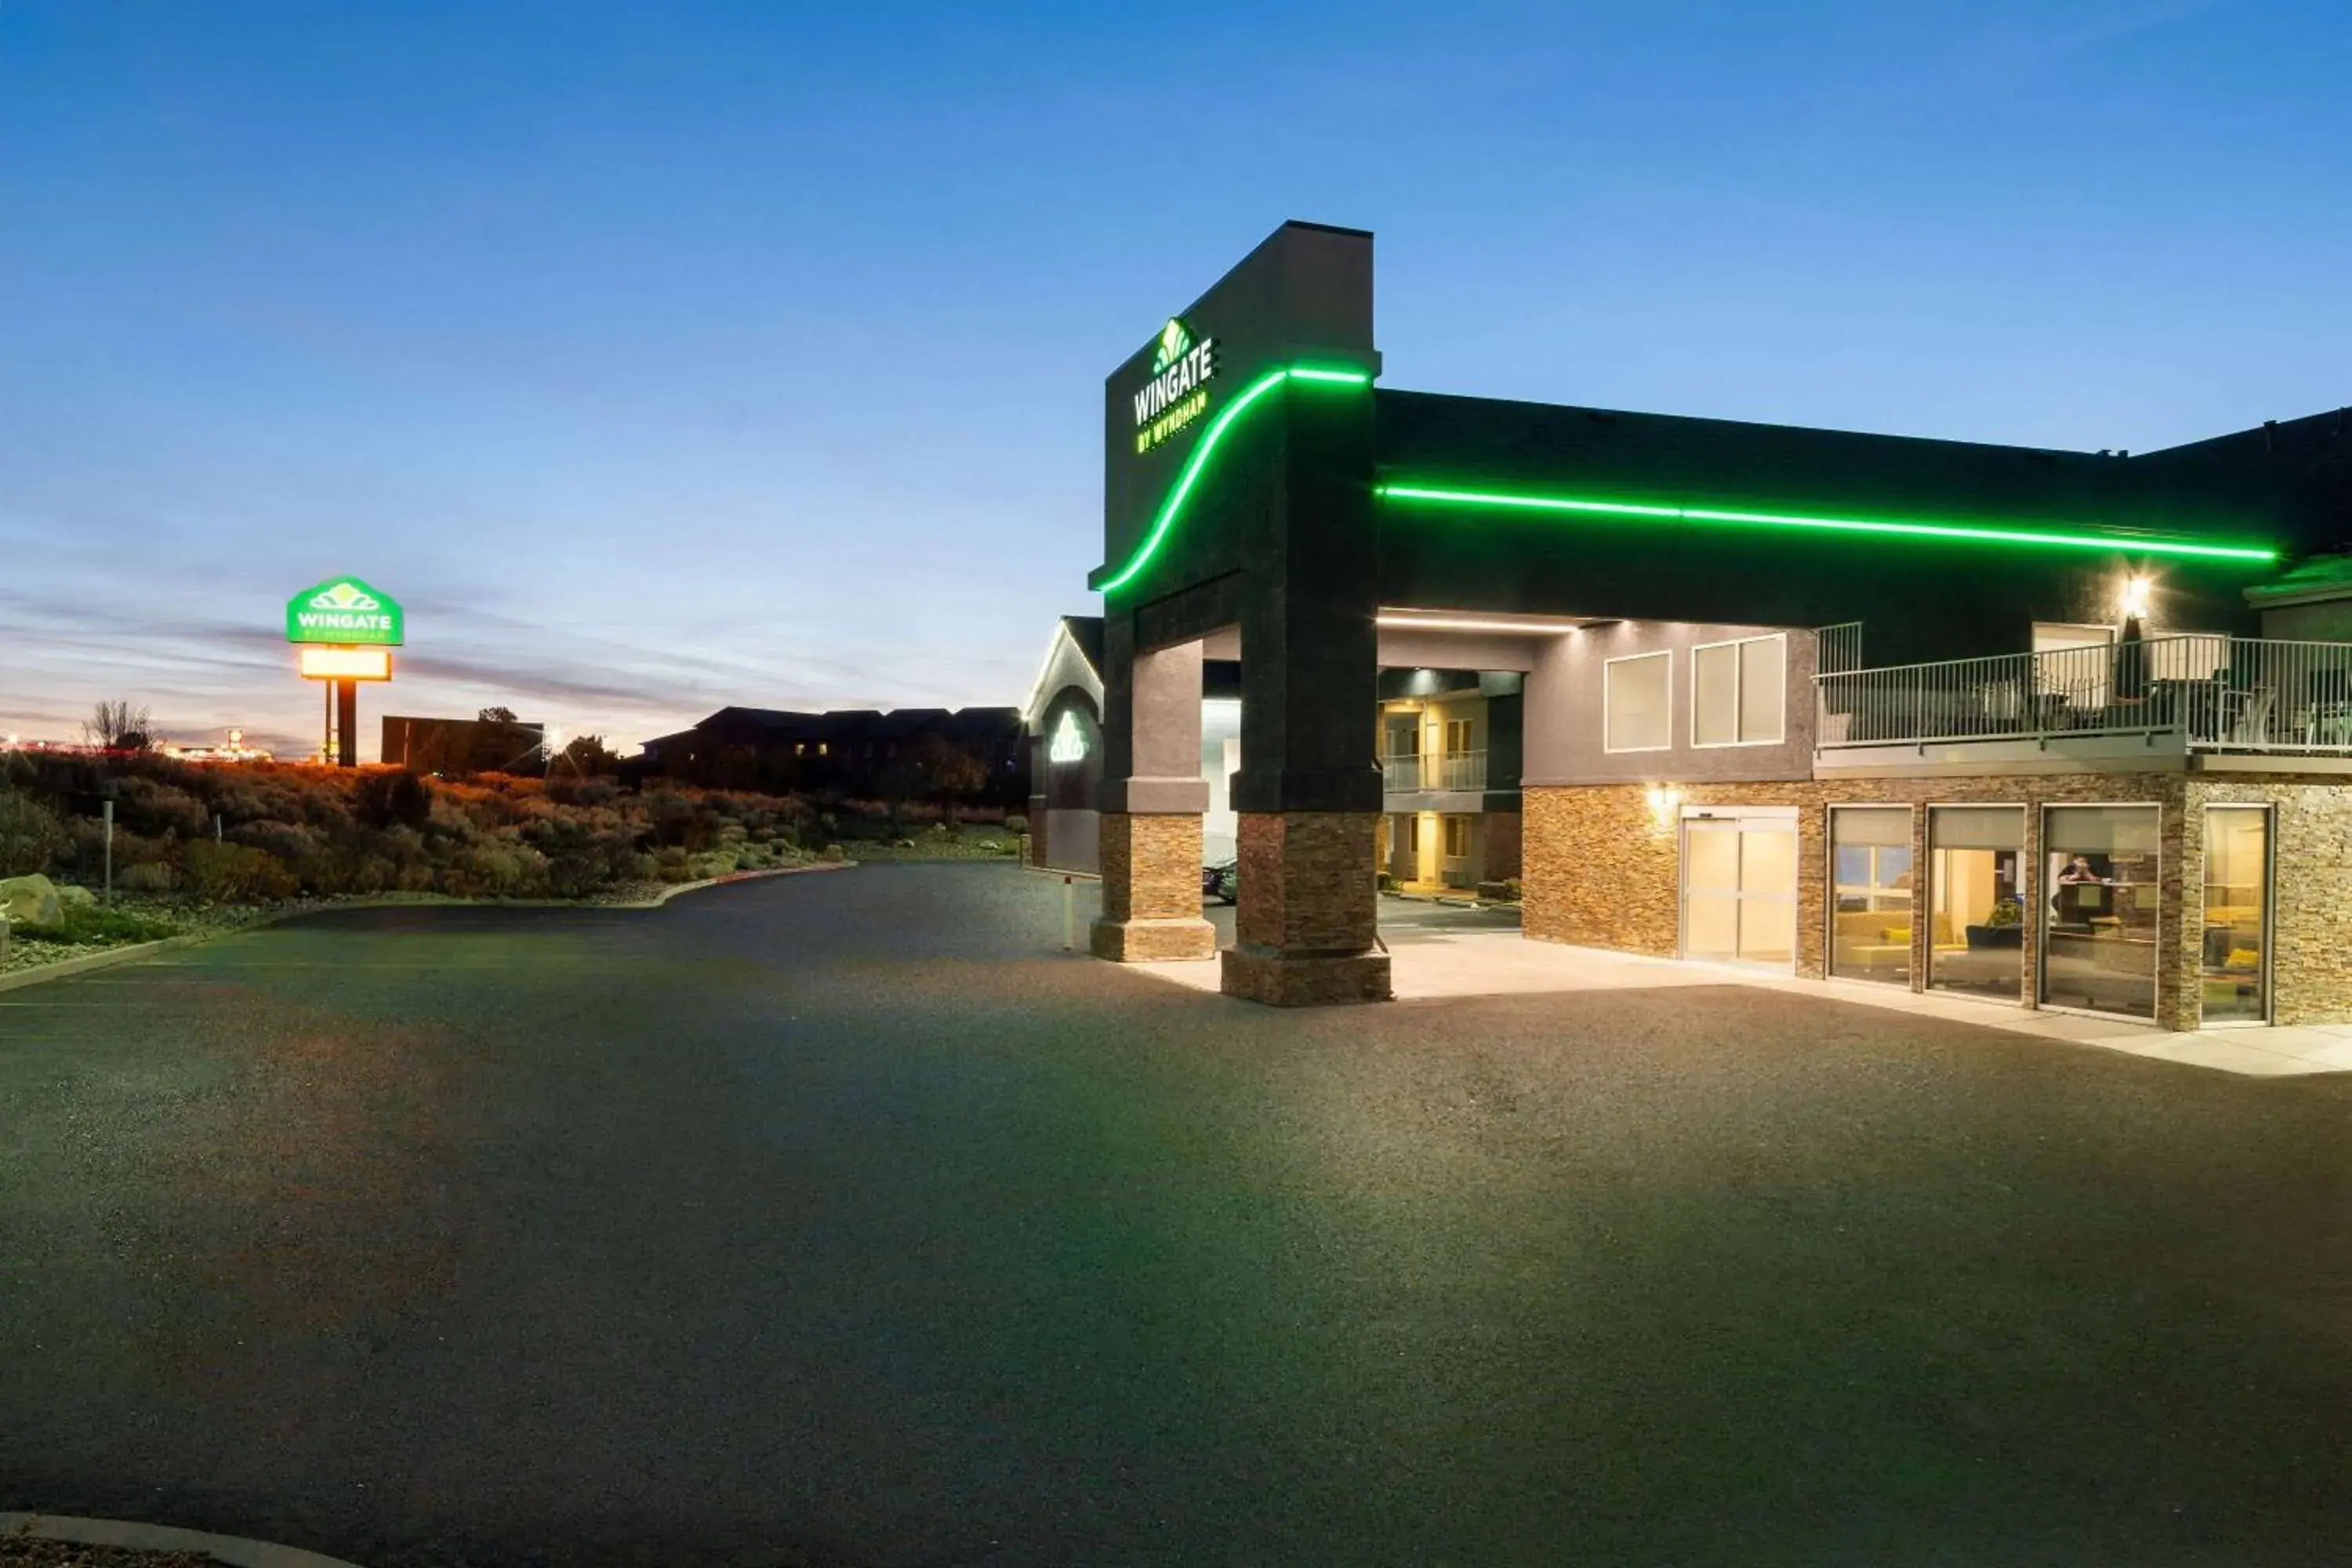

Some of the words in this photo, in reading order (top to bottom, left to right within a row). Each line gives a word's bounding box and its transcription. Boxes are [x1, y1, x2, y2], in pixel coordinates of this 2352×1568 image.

[1134, 338, 1212, 426] WINGATE
[1138, 429, 1151, 454] BY
[297, 612, 392, 630] WINGATE
